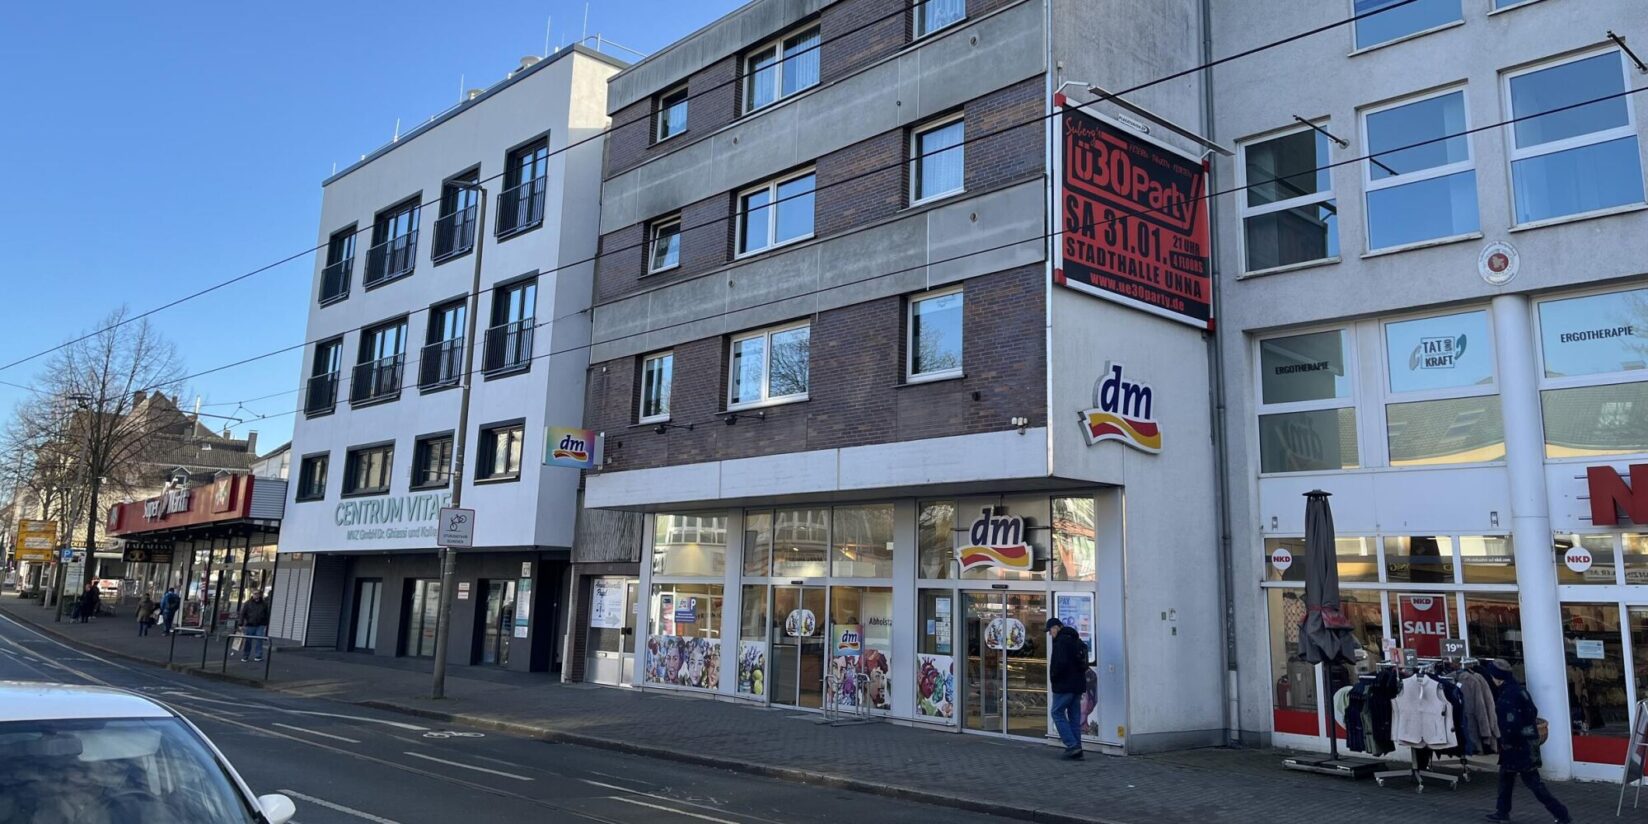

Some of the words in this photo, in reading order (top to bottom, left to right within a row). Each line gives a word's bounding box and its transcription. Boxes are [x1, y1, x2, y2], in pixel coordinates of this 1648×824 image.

[1066, 194, 1095, 240] SA
[1104, 208, 1167, 265] 31.01.
[1172, 235, 1183, 251] 21
[1184, 238, 1200, 255] UHR
[1066, 237, 1160, 284] STADTHALLE
[1165, 269, 1202, 299] UNNA
[1090, 272, 1185, 311] www.ue30party.de
[1560, 326, 1633, 343] ERGOTHERAPIE
[1423, 340, 1441, 354] TAT
[1275, 361, 1329, 375] ERGOTHERAPIE
[1425, 355, 1453, 367] KRAFT
[1101, 364, 1152, 420] dm
[560, 434, 585, 452] dm
[335, 497, 404, 527] CENTRUM
[971, 507, 1021, 546] dm
[1567, 555, 1590, 563] NKD
[842, 630, 858, 643] dm
[1403, 621, 1446, 635] SALE
